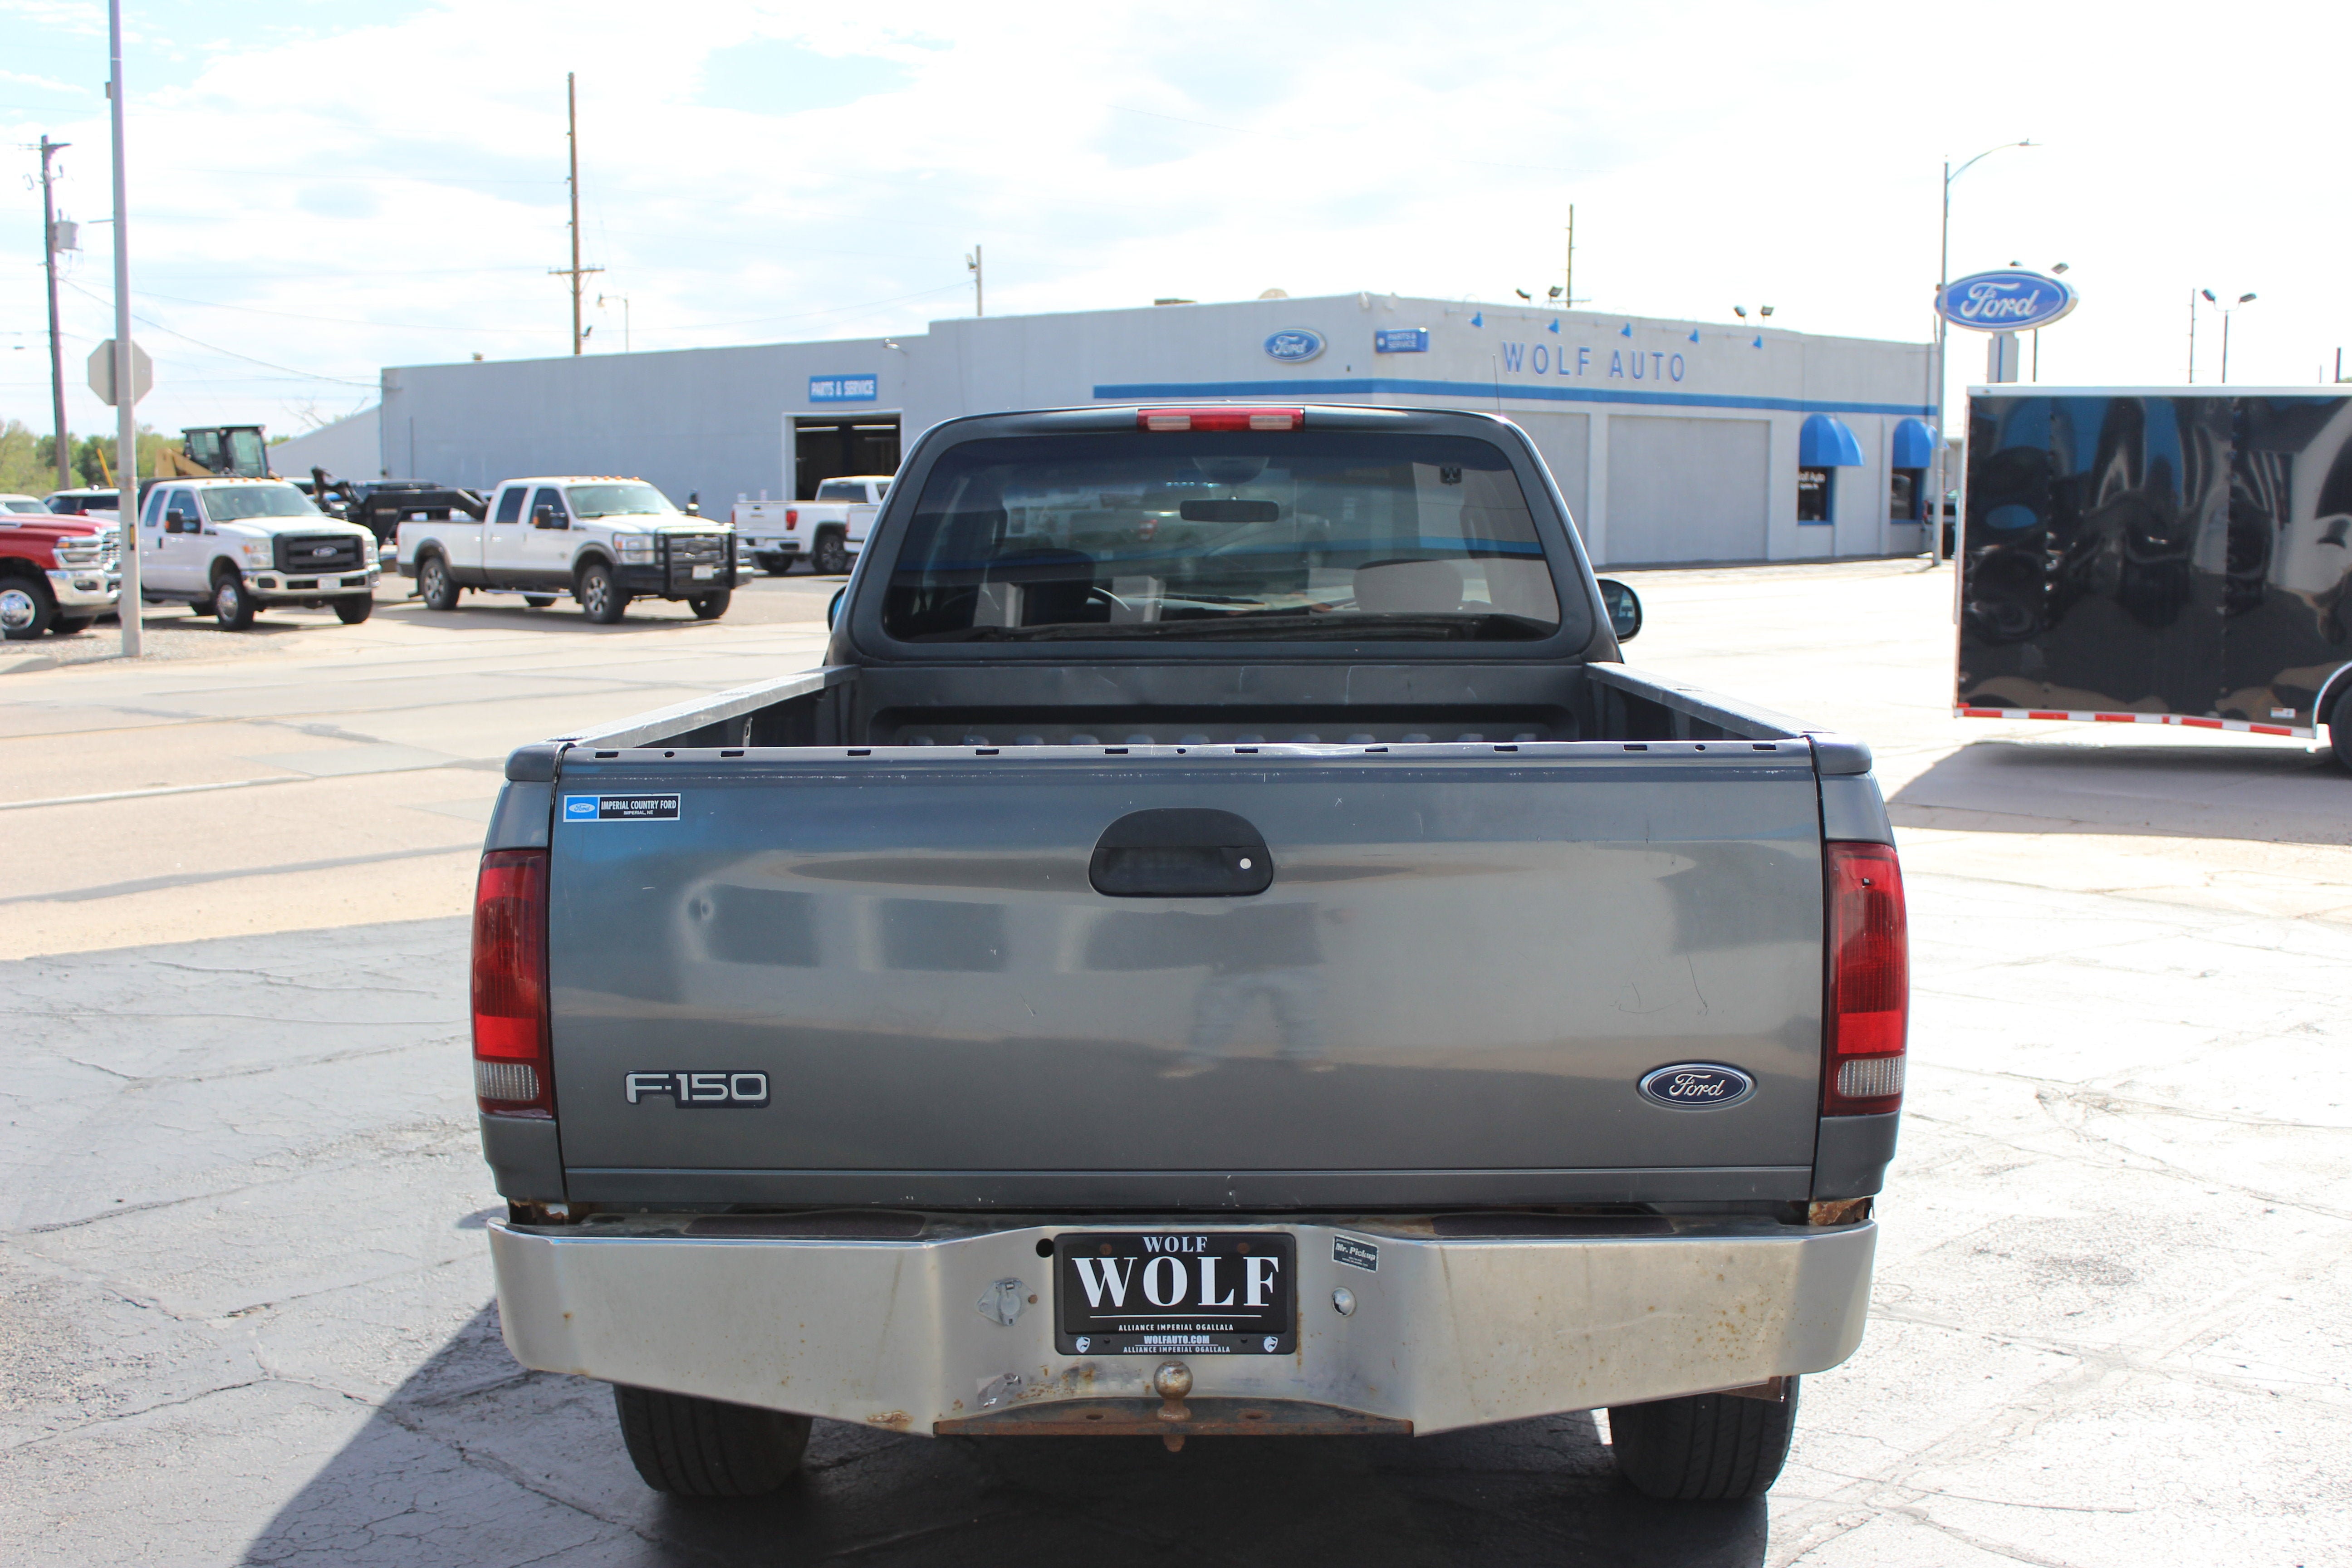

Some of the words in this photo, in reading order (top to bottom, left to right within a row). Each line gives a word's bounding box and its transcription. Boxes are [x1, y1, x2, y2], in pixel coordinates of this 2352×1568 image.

[1960, 282, 2040, 318] Ford
[1272, 336, 1308, 355] Ford
[1502, 341, 1591, 376] WOLF
[1608, 348, 1685, 382] AUTO
[811, 381, 834, 396] PARTS
[844, 379, 875, 395] SERVICE
[601, 801, 629, 810] IMPERIAL
[630, 800, 659, 810] COUNTRY
[660, 800, 677, 809] FORD
[1669, 1073, 1725, 1096] Ford
[1142, 1236, 1208, 1253] WOLF
[1335, 1243, 1348, 1253] Mr.
[1349, 1246, 1376, 1261] Pickup
[1072, 1256, 1279, 1308] WOLF
[1143, 1335, 1210, 1344] WOLFAUTO.COM
